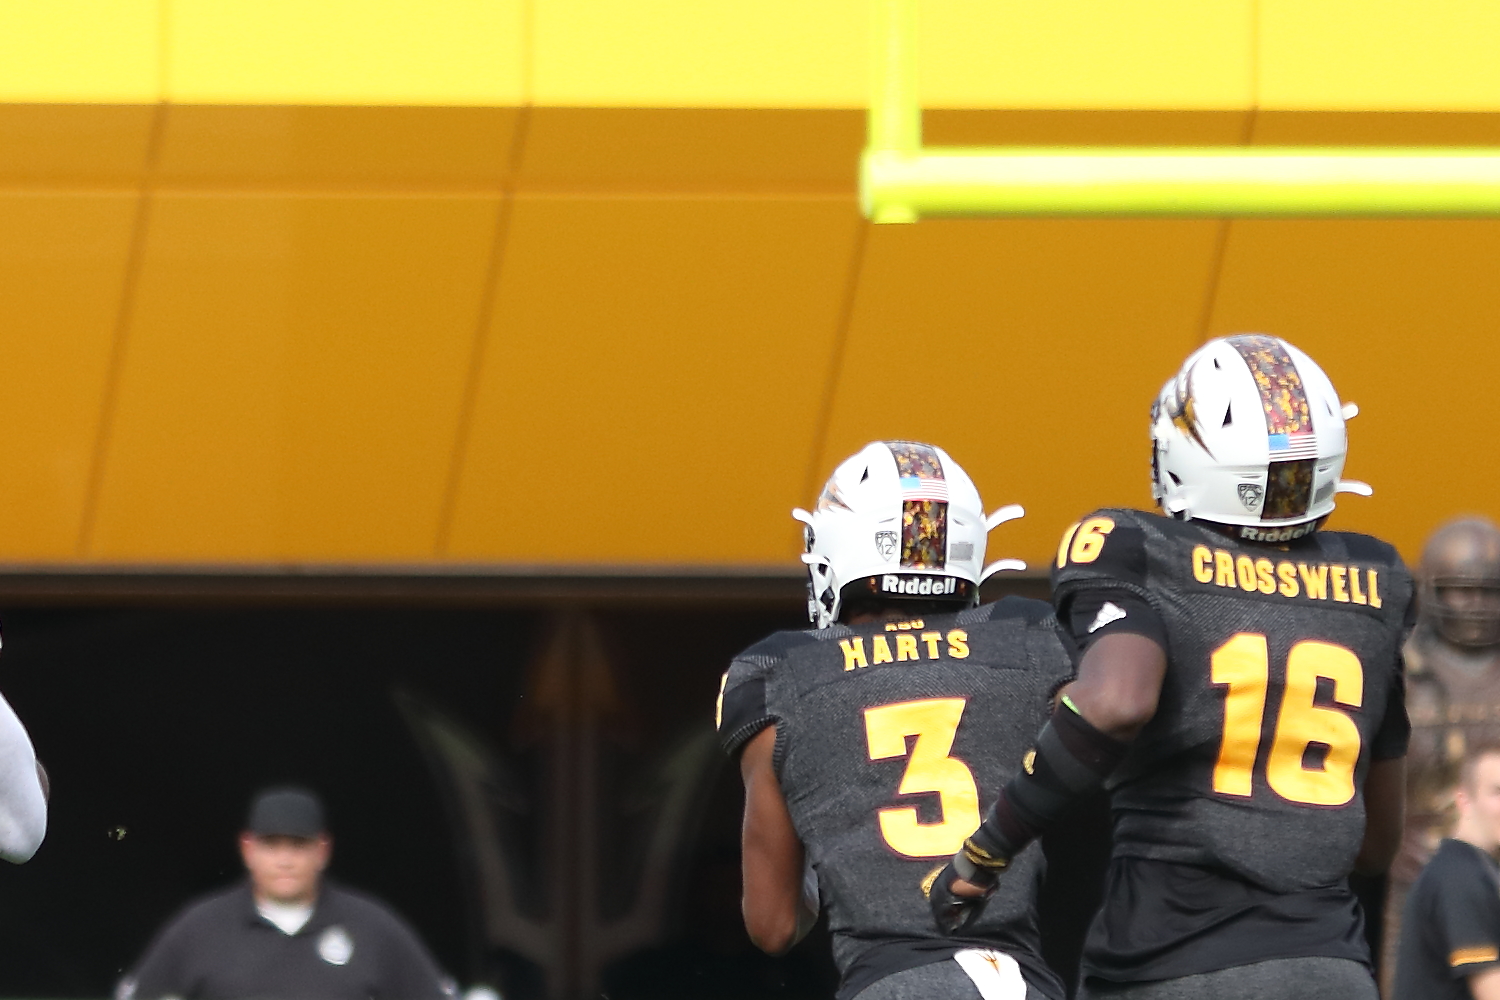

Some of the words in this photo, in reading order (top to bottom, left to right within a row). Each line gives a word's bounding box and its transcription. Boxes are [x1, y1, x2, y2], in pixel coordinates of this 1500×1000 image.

[1056, 517, 1116, 569] 16
[1240, 519, 1317, 542] Riddell
[882, 574, 957, 595] Riddell
[1191, 544, 1383, 609] CROSSWELL
[838, 628, 970, 672] HARTS
[1210, 631, 1365, 806] 16
[863, 697, 982, 858] 3
